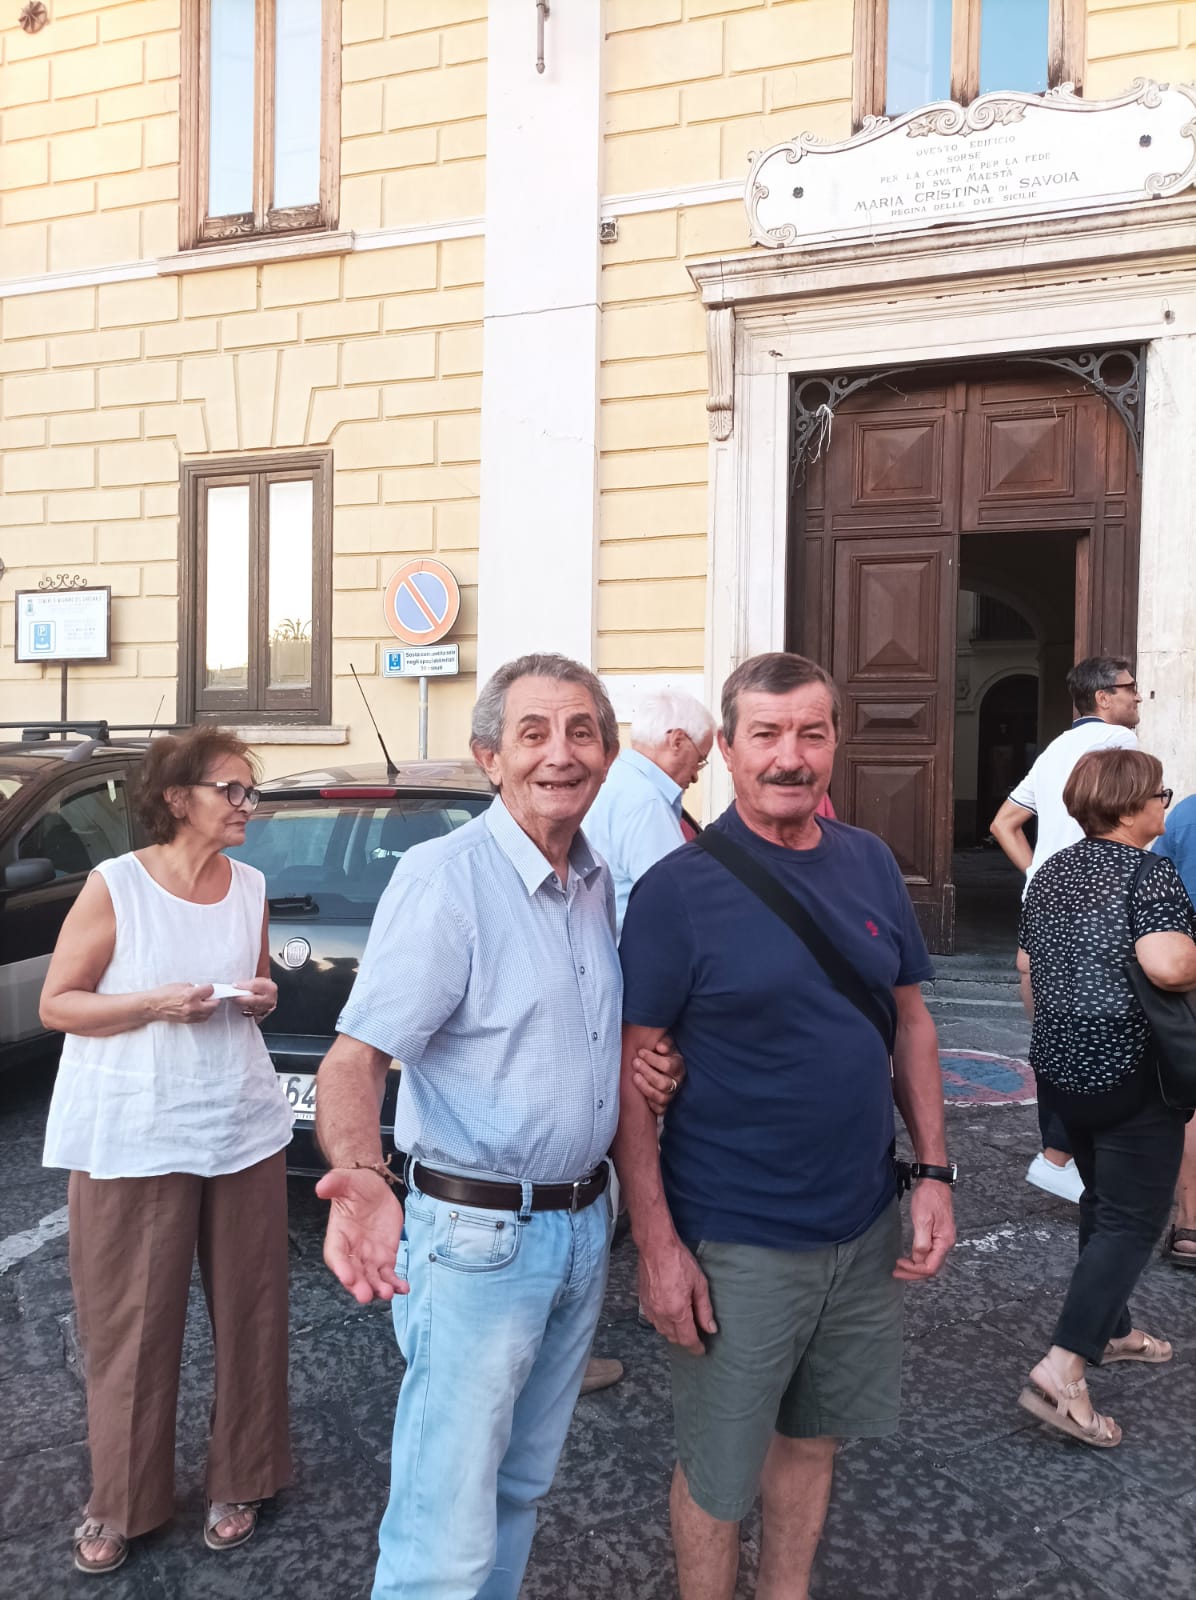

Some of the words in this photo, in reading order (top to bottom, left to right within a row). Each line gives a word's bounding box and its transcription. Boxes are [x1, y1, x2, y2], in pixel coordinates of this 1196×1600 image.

[969, 135, 1016, 149] EDIFICIO
[880, 175, 898, 184] PER
[905, 171, 920, 180] LA
[980, 160, 999, 169] PER
[1005, 157, 1018, 166] LA
[1025, 152, 1051, 163] FEDE
[946, 151, 981, 163] SORSE
[915, 181, 925, 190] DI
[932, 178, 951, 187] SVA
[966, 166, 1013, 182] MAESTÀ
[854, 195, 904, 212] MARIA
[914, 184, 990, 203] CRISTINA
[998, 184, 1008, 192] DI
[1019, 171, 1080, 189] SAVOIA
[891, 206, 927, 216] REGINA
[934, 200, 965, 211] DELLE
[973, 197, 993, 206] DVE
[1003, 191, 1037, 201] SICILIE
